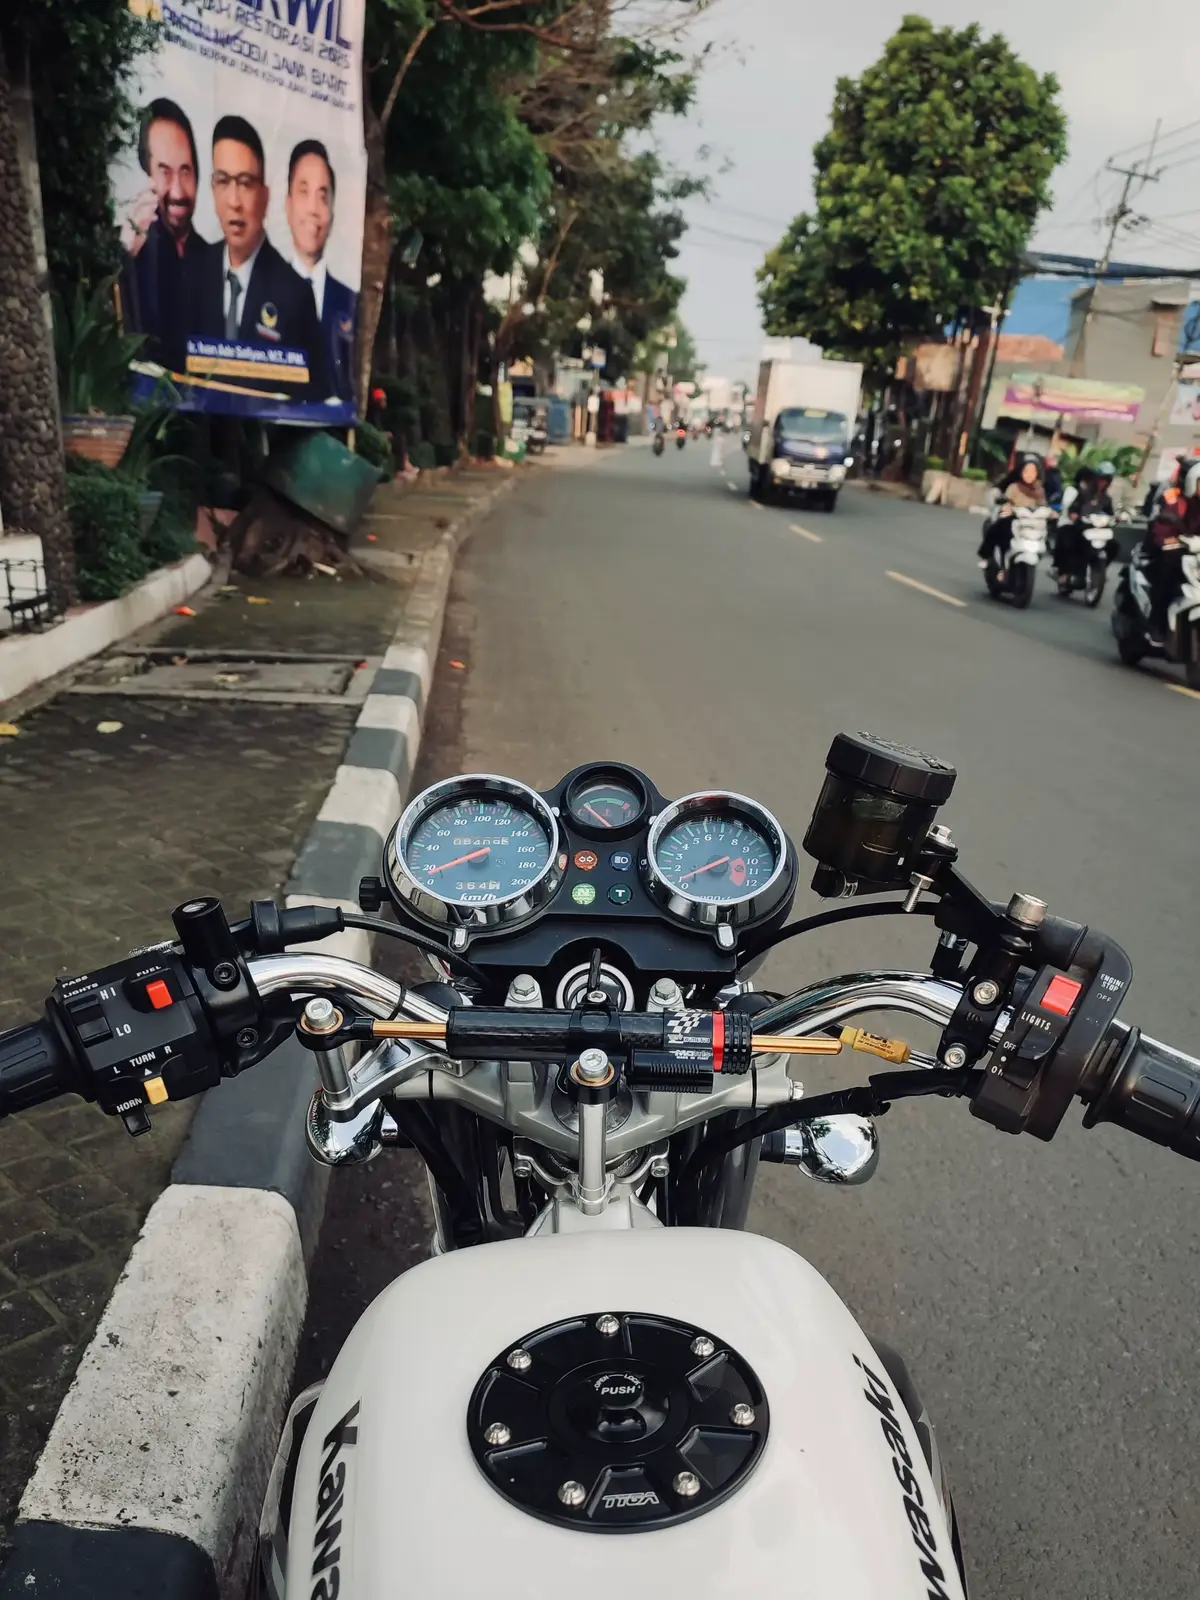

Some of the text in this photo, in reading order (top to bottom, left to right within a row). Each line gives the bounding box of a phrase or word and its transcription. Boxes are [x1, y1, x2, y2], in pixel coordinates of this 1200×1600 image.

[692, 837, 700, 845] 5
[731, 838, 739, 846] 8
[426, 844, 440, 852] 40
[675, 852, 683, 860] 3
[746, 857, 759, 865] 10
[681, 882, 689, 890] 0
[459, 892, 497, 900] km/h
[615, 889, 626, 898] T
[136, 965, 162, 977] FUEL
[61, 975, 88, 988] PASS
[1101, 981, 1119, 992] STOP
[63, 982, 99, 998] LIGHTS
[100, 987, 117, 1000] HI
[1096, 992, 1112, 1002] OFF
[1021, 1011, 1052, 1031] LIGHTS
[116, 1024, 132, 1037] LO
[164, 1045, 172, 1054] R
[1003, 1040, 1017, 1051] OFF
[129, 1052, 156, 1067] TURN
[113, 1066, 121, 1074] L
[116, 1097, 143, 1113] HORN
[594, 1374, 609, 1388] OPEN
[624, 1373, 642, 1386] LOCK
[601, 1385, 636, 1395] PUSH
